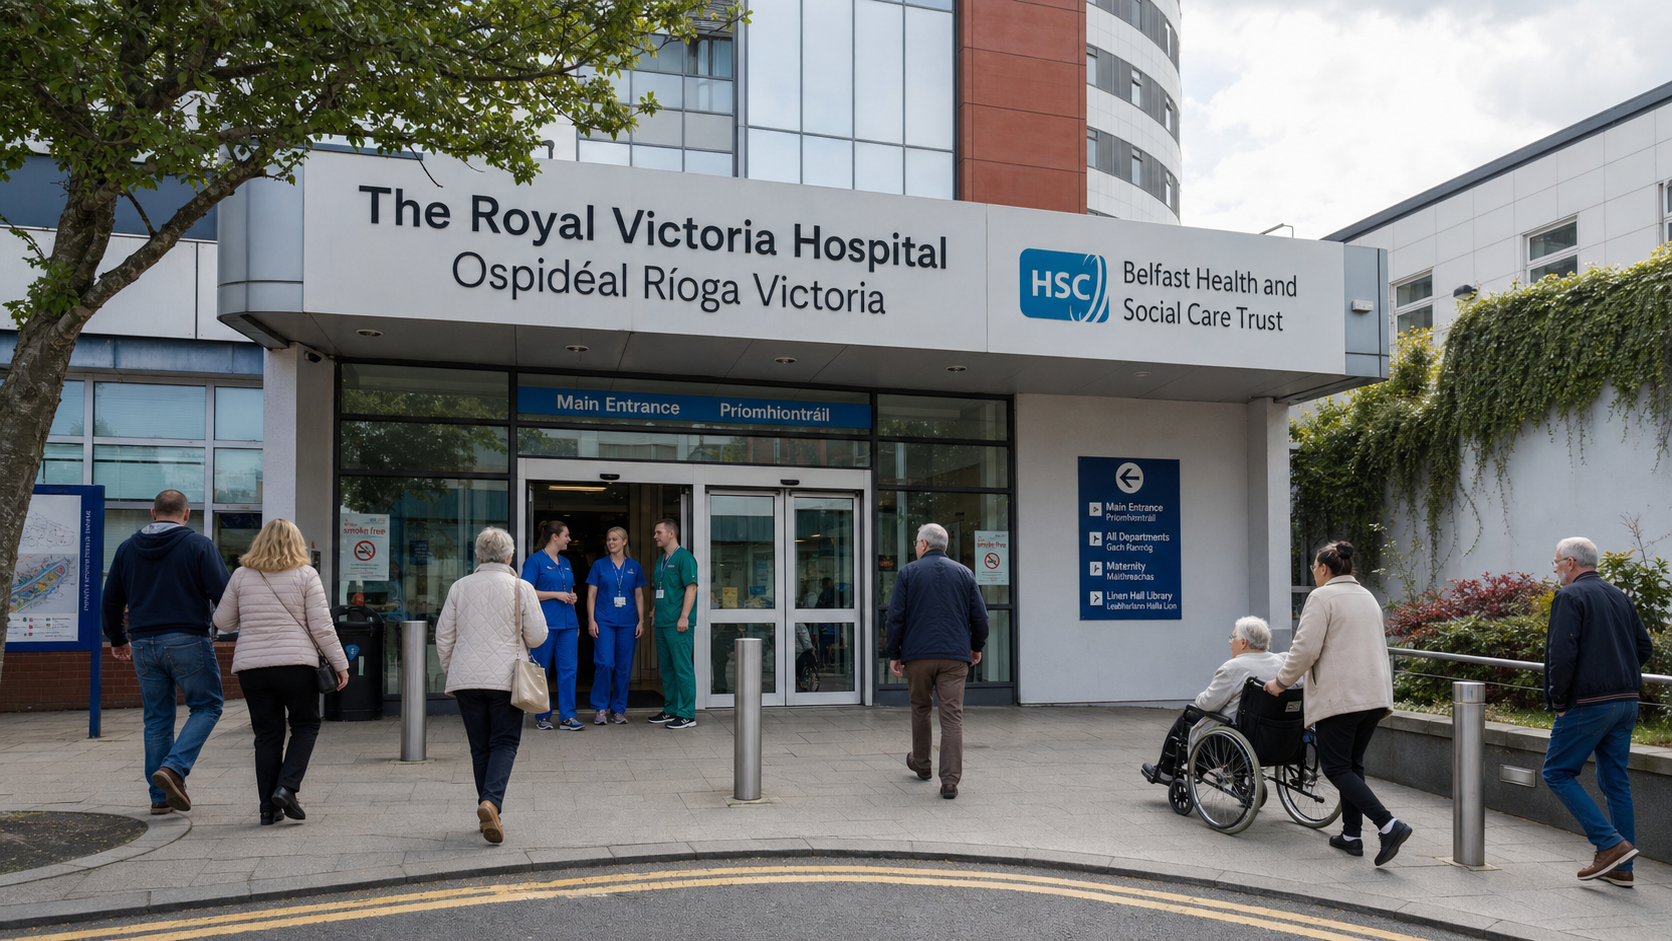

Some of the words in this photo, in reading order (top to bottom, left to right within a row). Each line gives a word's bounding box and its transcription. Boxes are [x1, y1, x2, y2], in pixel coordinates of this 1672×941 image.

[358, 184, 451, 230] The
[471, 194, 595, 247] Royal
[611, 206, 778, 256] Victoria
[794, 223, 947, 273] Hospital
[452, 251, 627, 301] Ospidéal
[644, 265, 741, 313] Ríoga
[752, 272, 886, 315] Victoria
[1031, 269, 1091, 300] HSC
[1123, 260, 1191, 289] Belfast
[1196, 267, 1258, 294] Health
[1263, 274, 1297, 298] and
[1123, 297, 1181, 325] Social
[1187, 302, 1231, 328] Care
[1235, 306, 1284, 332] Trust
[556, 394, 599, 411] Main
[605, 397, 680, 416] Entrance
[720, 402, 830, 422] Príomhiontráil
[1106, 502, 1126, 511] Main
[1128, 503, 1163, 512] Entrance
[370, 526, 385, 535] free
[1106, 532, 1117, 541] All
[1106, 543, 1125, 551] Gach
[1106, 561, 1146, 573] Maternity
[1106, 591, 1128, 600] Linen
[1130, 591, 1145, 600] Hall
[1146, 591, 1173, 603] Library
